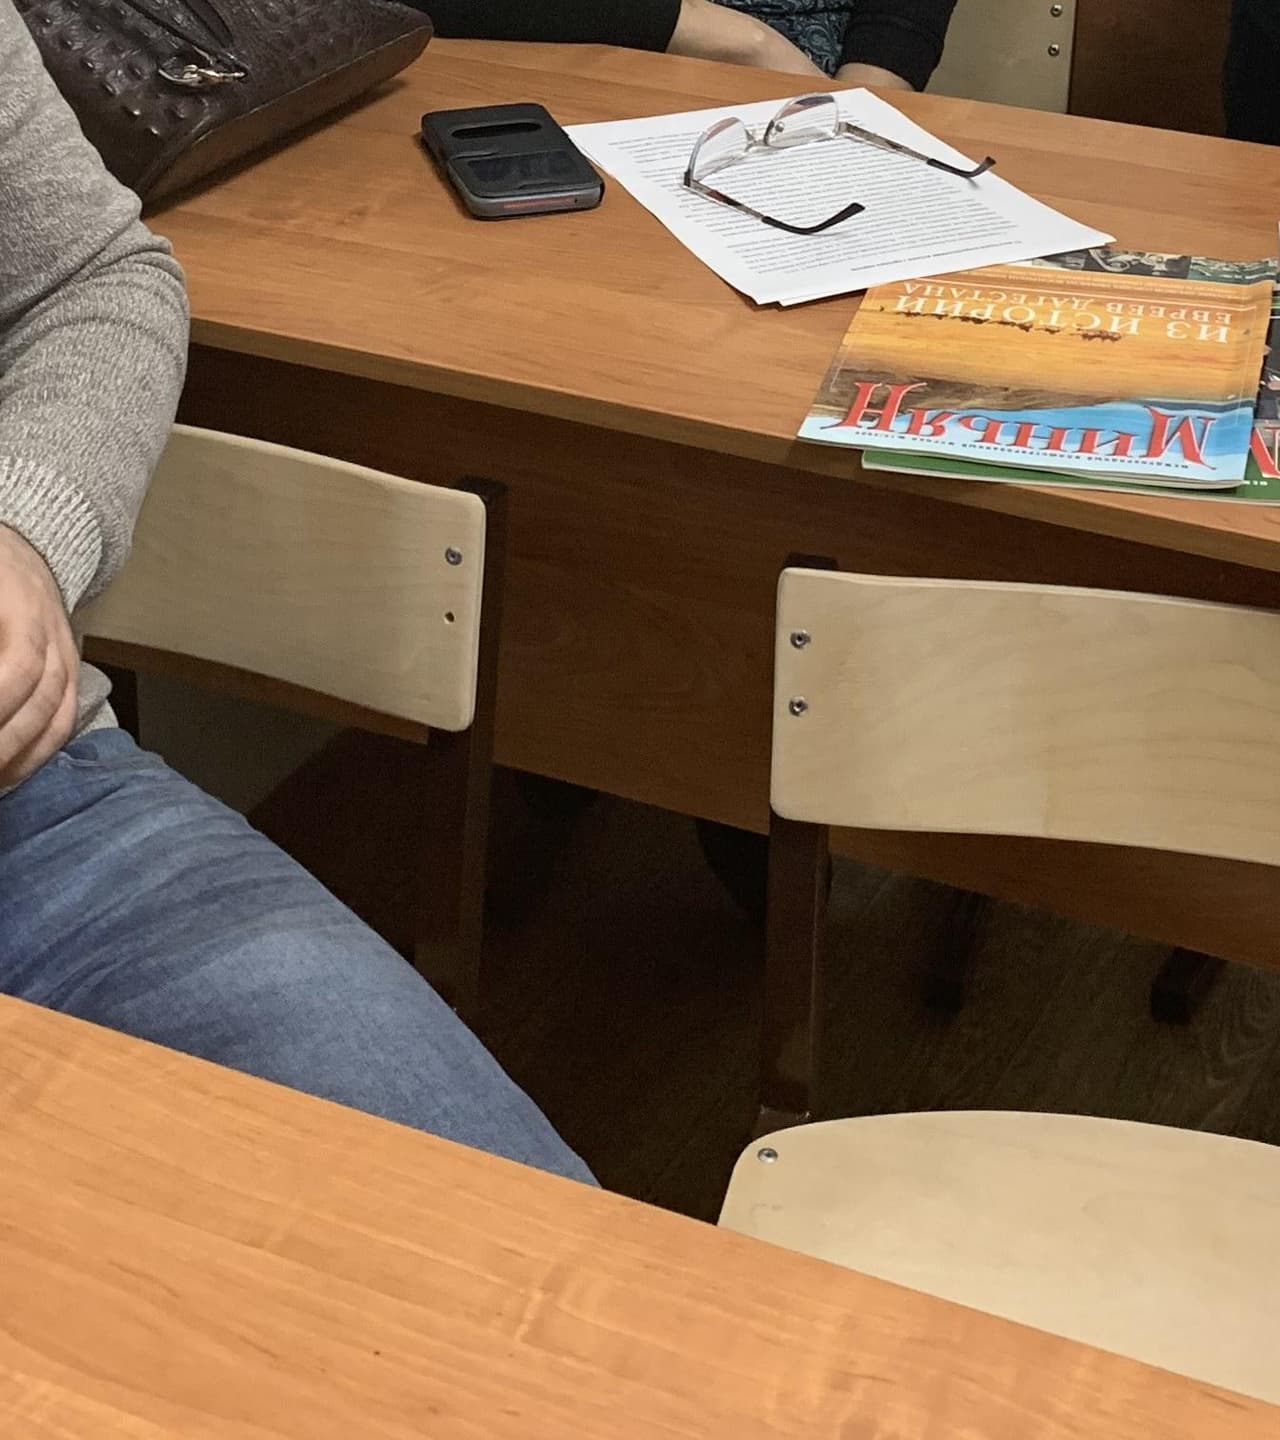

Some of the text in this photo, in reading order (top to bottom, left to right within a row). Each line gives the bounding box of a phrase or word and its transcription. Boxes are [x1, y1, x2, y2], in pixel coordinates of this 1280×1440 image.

[902, 281, 1096, 310] ДАГЕСТАНА
[893, 294, 1230, 345] ИЗ ИСТОРИИ
[1105, 301, 1233, 326] ЕВРЕЕВ
